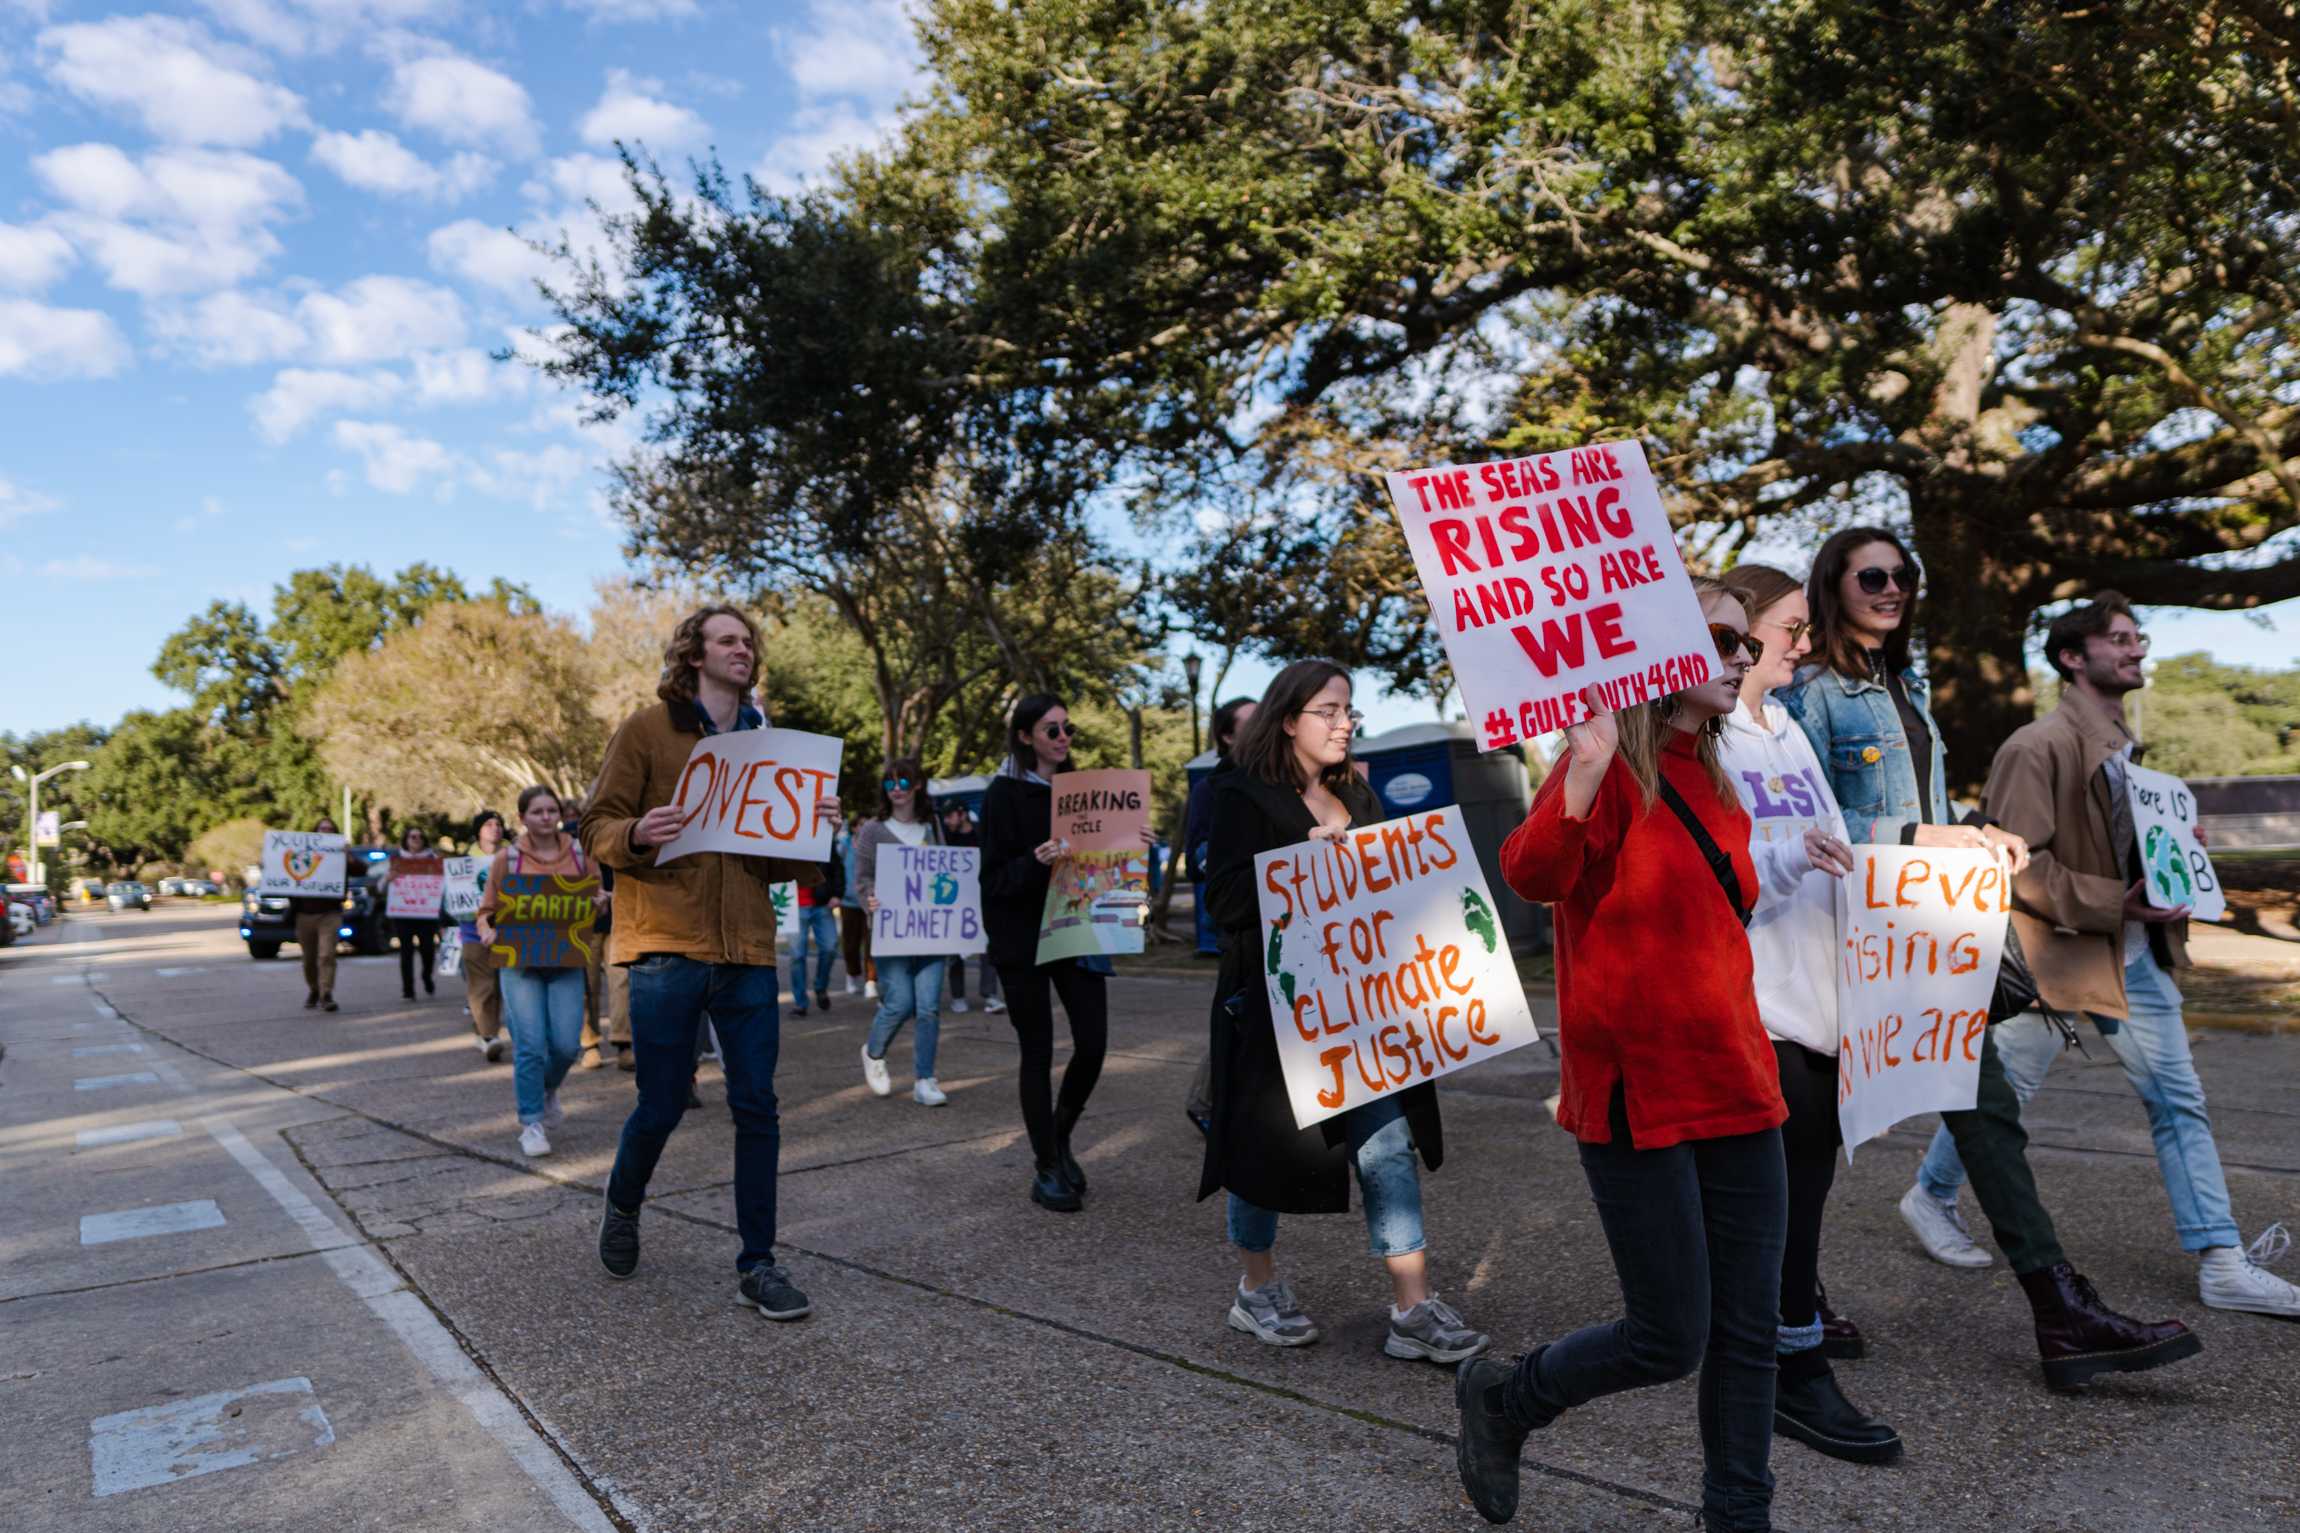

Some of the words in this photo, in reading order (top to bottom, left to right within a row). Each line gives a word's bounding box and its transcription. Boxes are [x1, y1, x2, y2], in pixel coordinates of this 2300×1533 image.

[1408, 470, 1475, 513] THE
[1480, 456, 1561, 503] SEAS
[1570, 447, 1624, 486] ARE
[1429, 487, 1635, 577] RISING
[1453, 576, 1535, 633] AND
[1540, 562, 1590, 607] SO
[1599, 545, 1665, 595] ARE
[1511, 602, 1638, 679] WE
[677, 751, 837, 841] DIVEST
[1057, 789, 1141, 816] BREAKING
[1071, 820, 1102, 835] CYCLE
[2190, 850, 2214, 892] B
[515, 894, 592, 920] EARTH
[880, 909, 954, 939] PLANET
[961, 907, 979, 940] B
[1912, 1007, 1988, 1063] are
